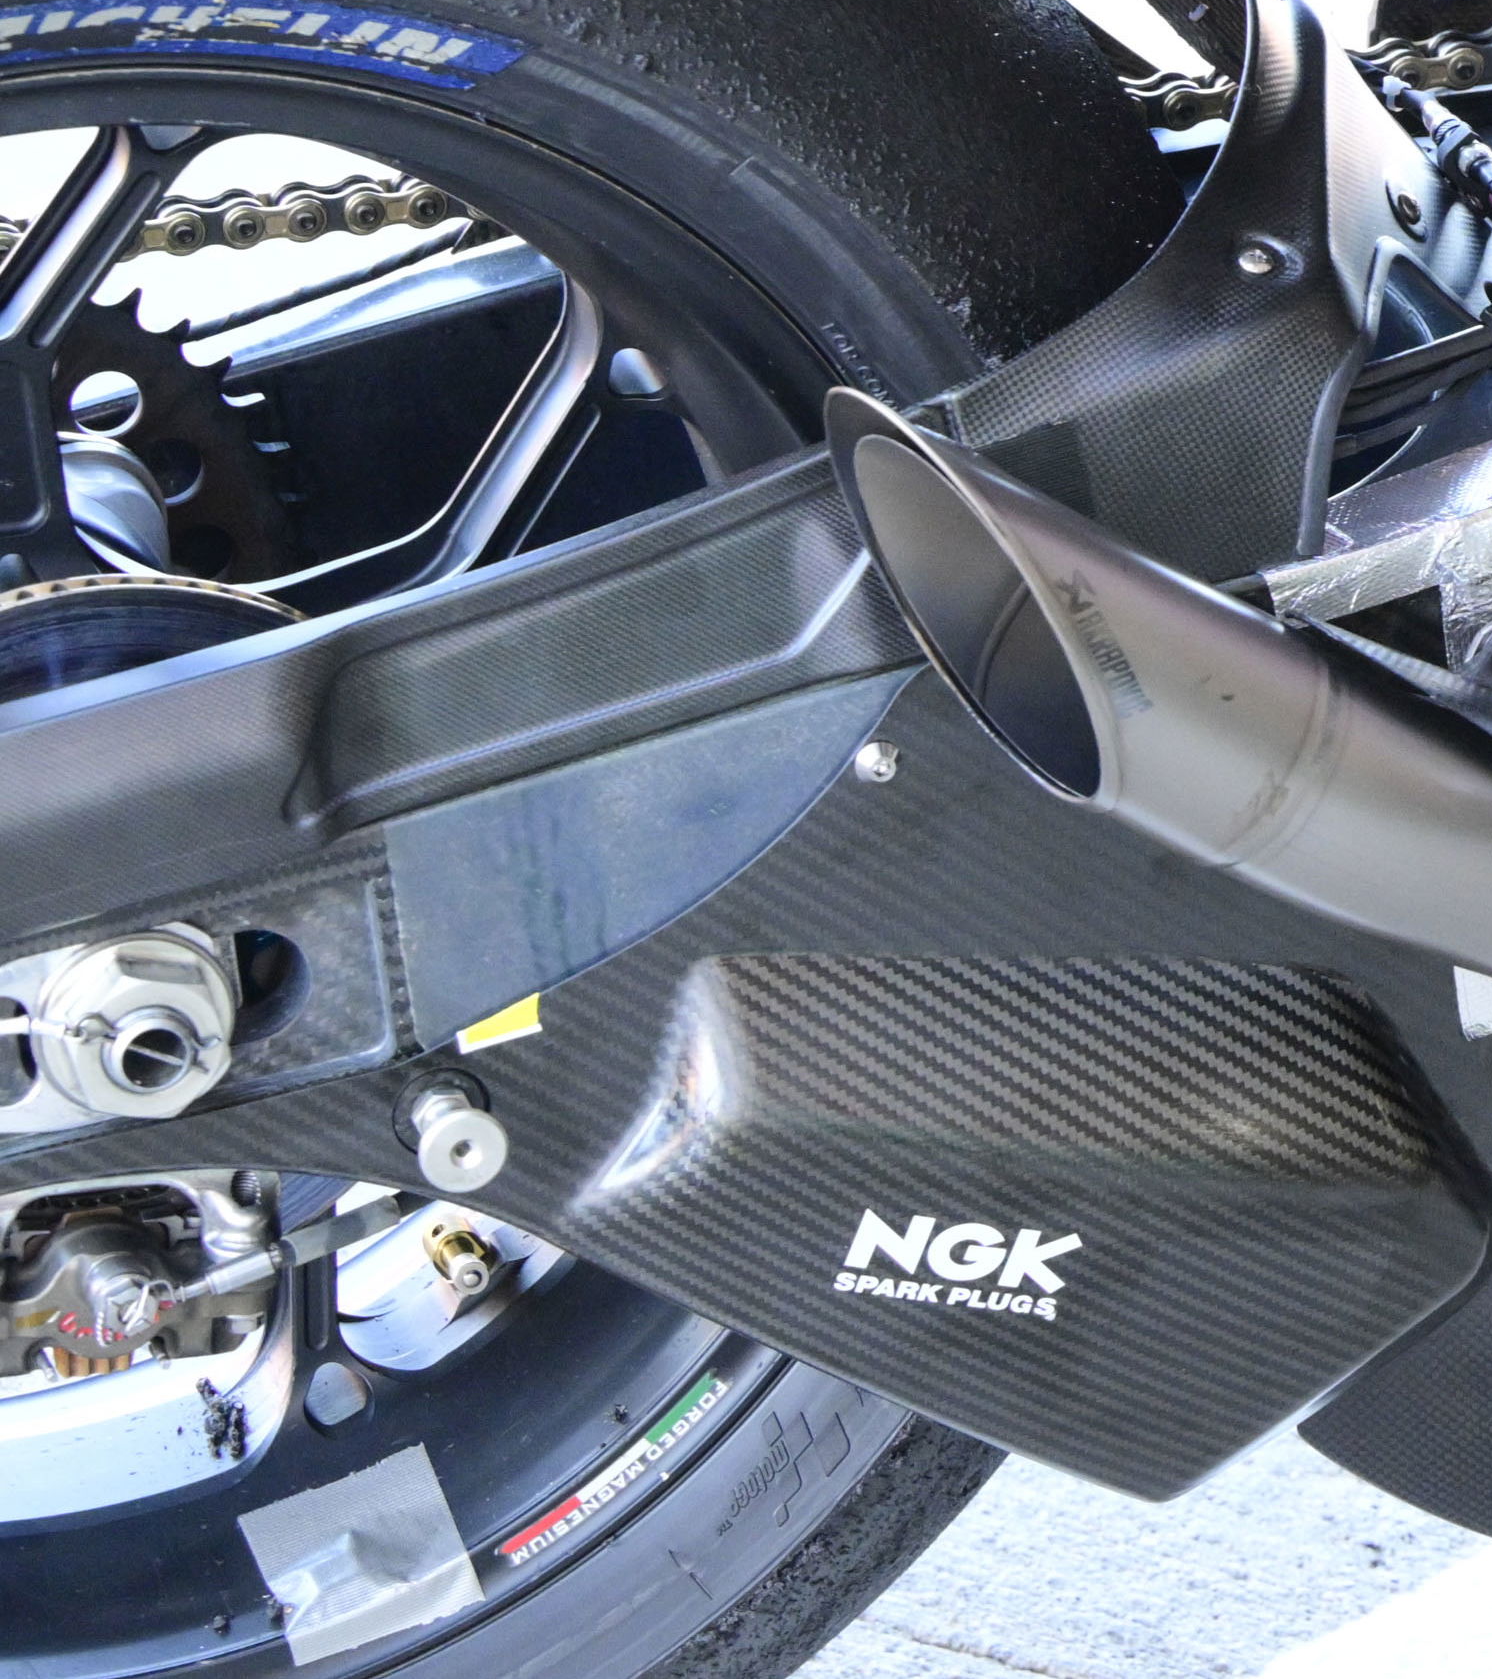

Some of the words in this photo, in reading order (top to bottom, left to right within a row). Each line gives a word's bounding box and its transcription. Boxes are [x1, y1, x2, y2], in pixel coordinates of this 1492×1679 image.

[843, 1207, 1084, 1295] NGK
[833, 1271, 944, 1304] SPARK
[946, 1286, 1058, 1319] PLUGS
[646, 1378, 730, 1463] FORGED
[509, 1457, 646, 1569] MAGNESIUM
